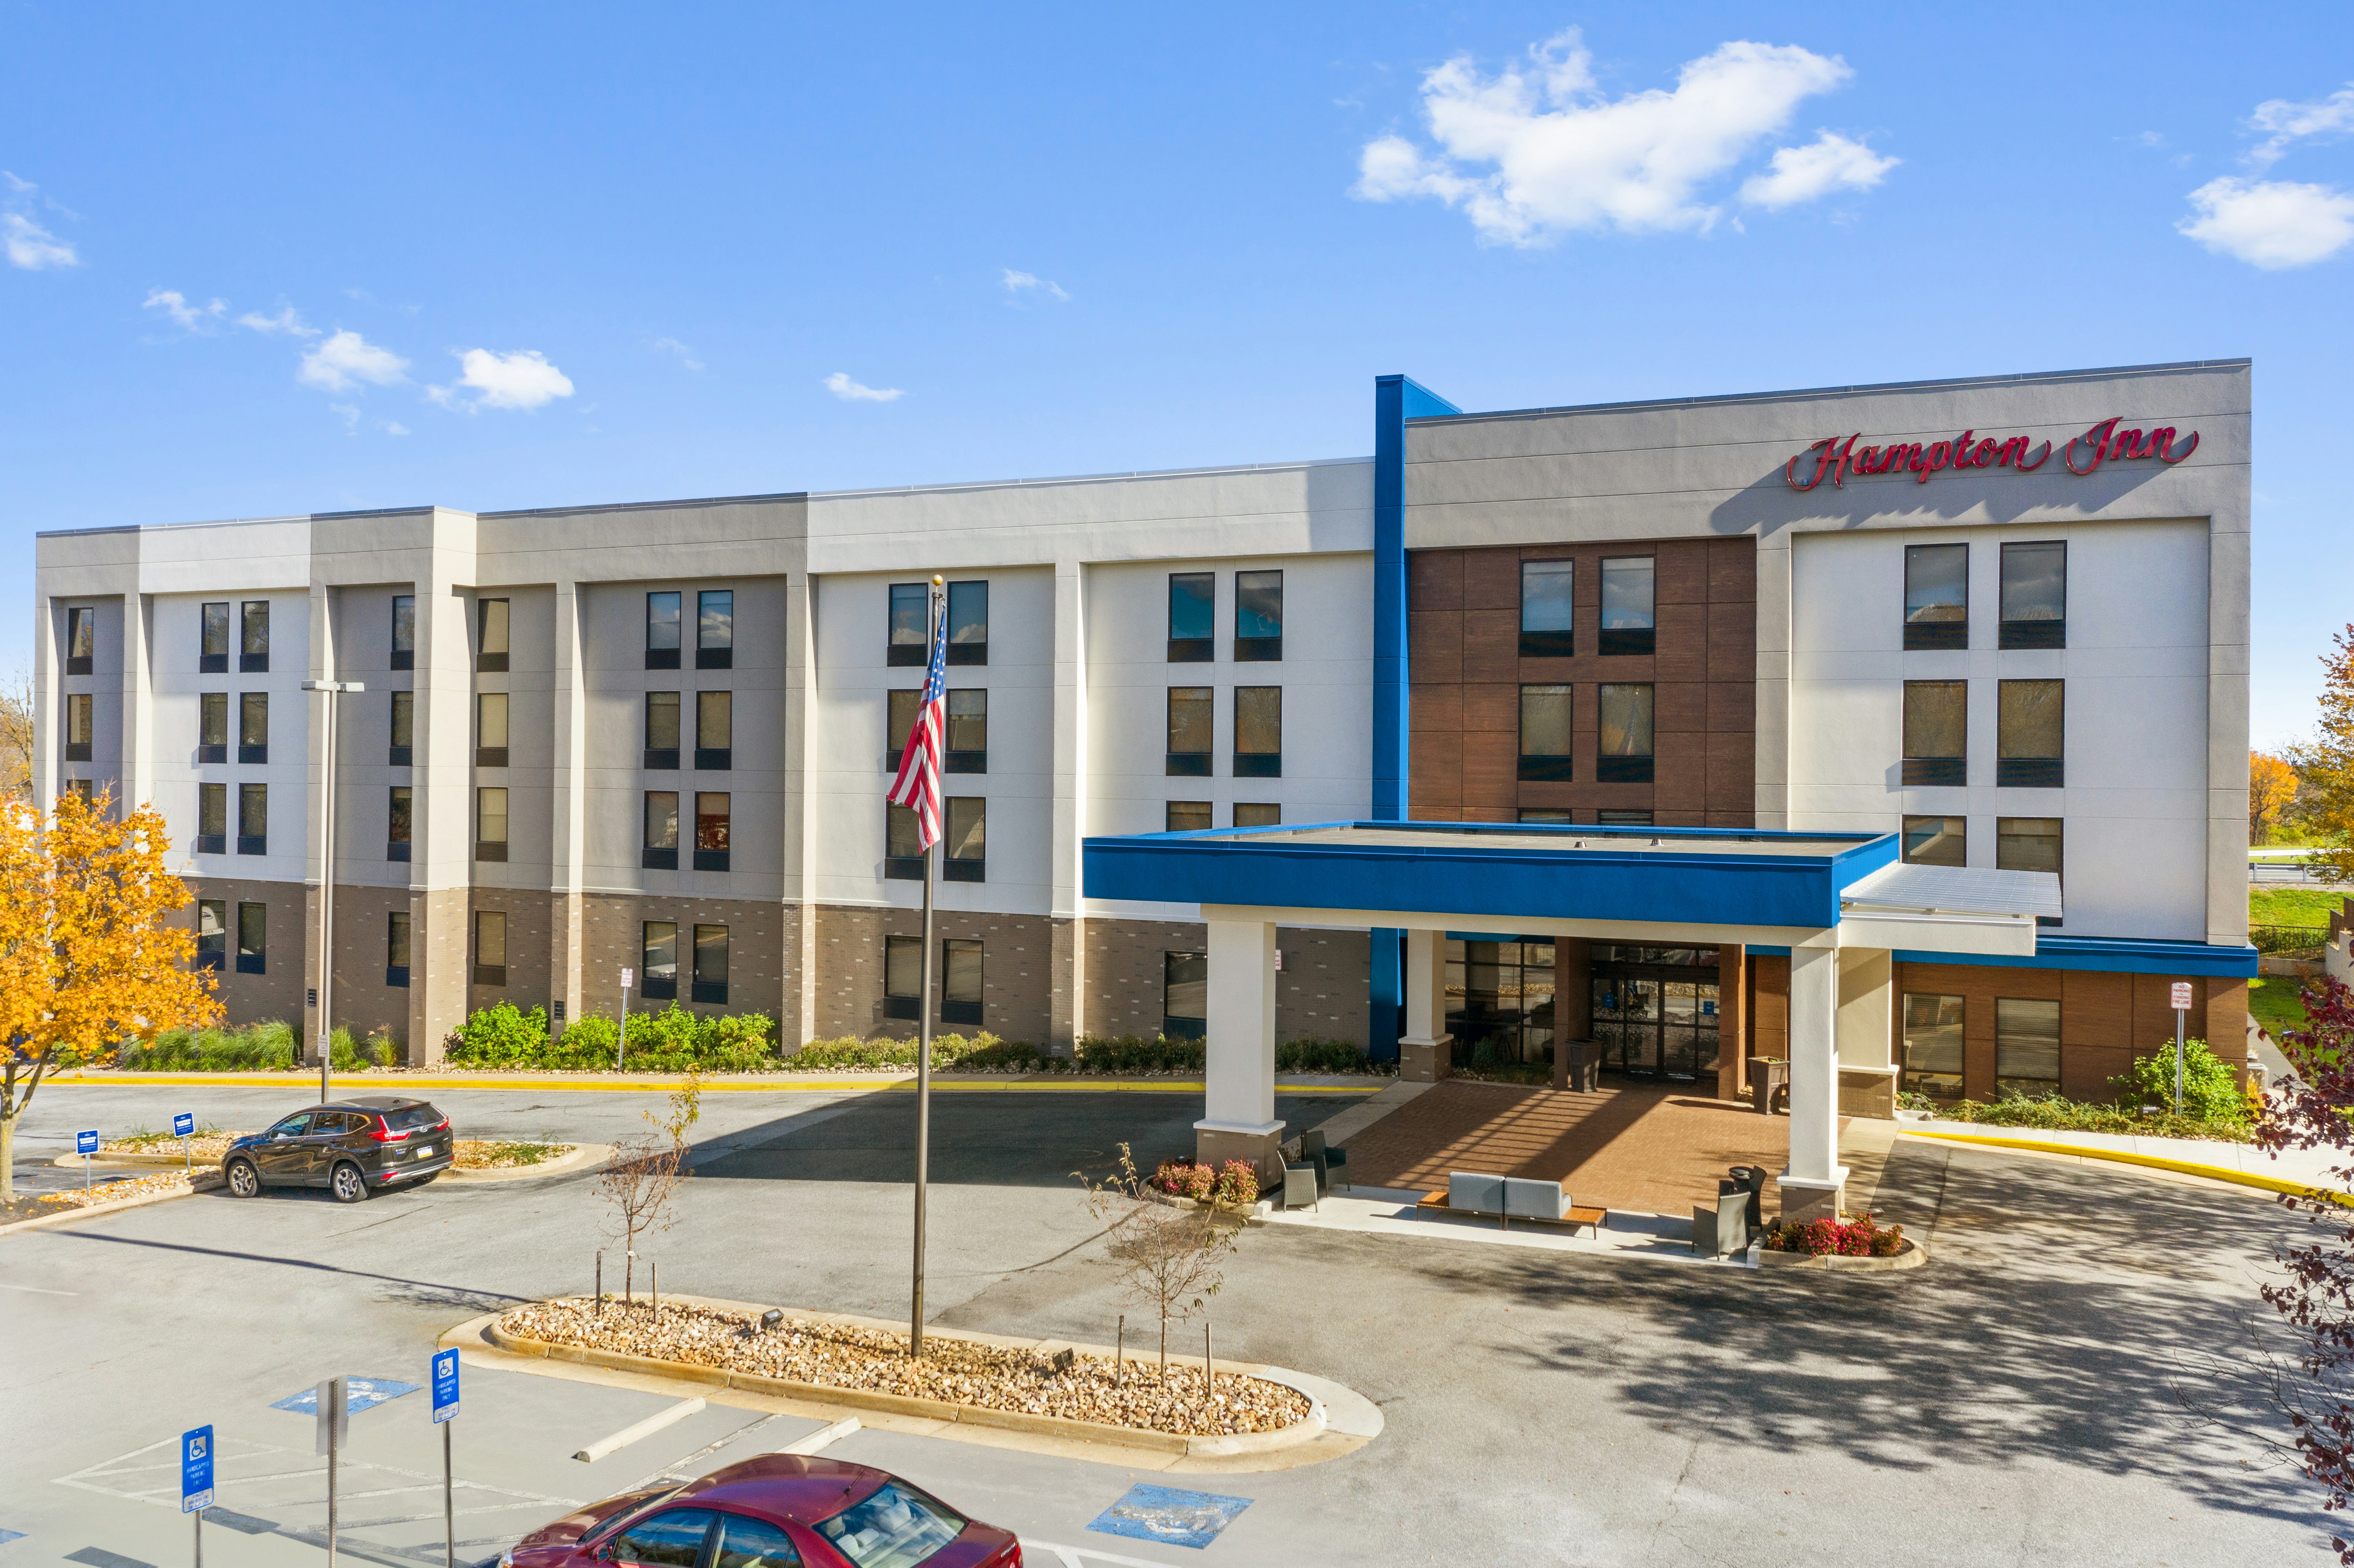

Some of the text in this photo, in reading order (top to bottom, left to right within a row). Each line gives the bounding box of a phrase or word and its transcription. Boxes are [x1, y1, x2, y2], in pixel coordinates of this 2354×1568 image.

[1787, 416, 2200, 491] Hampton Inn
[187, 1461, 209, 1473] HANDICAPPED
[190, 1469, 206, 1479] PARKING
[193, 1478, 202, 1487] ONLY
